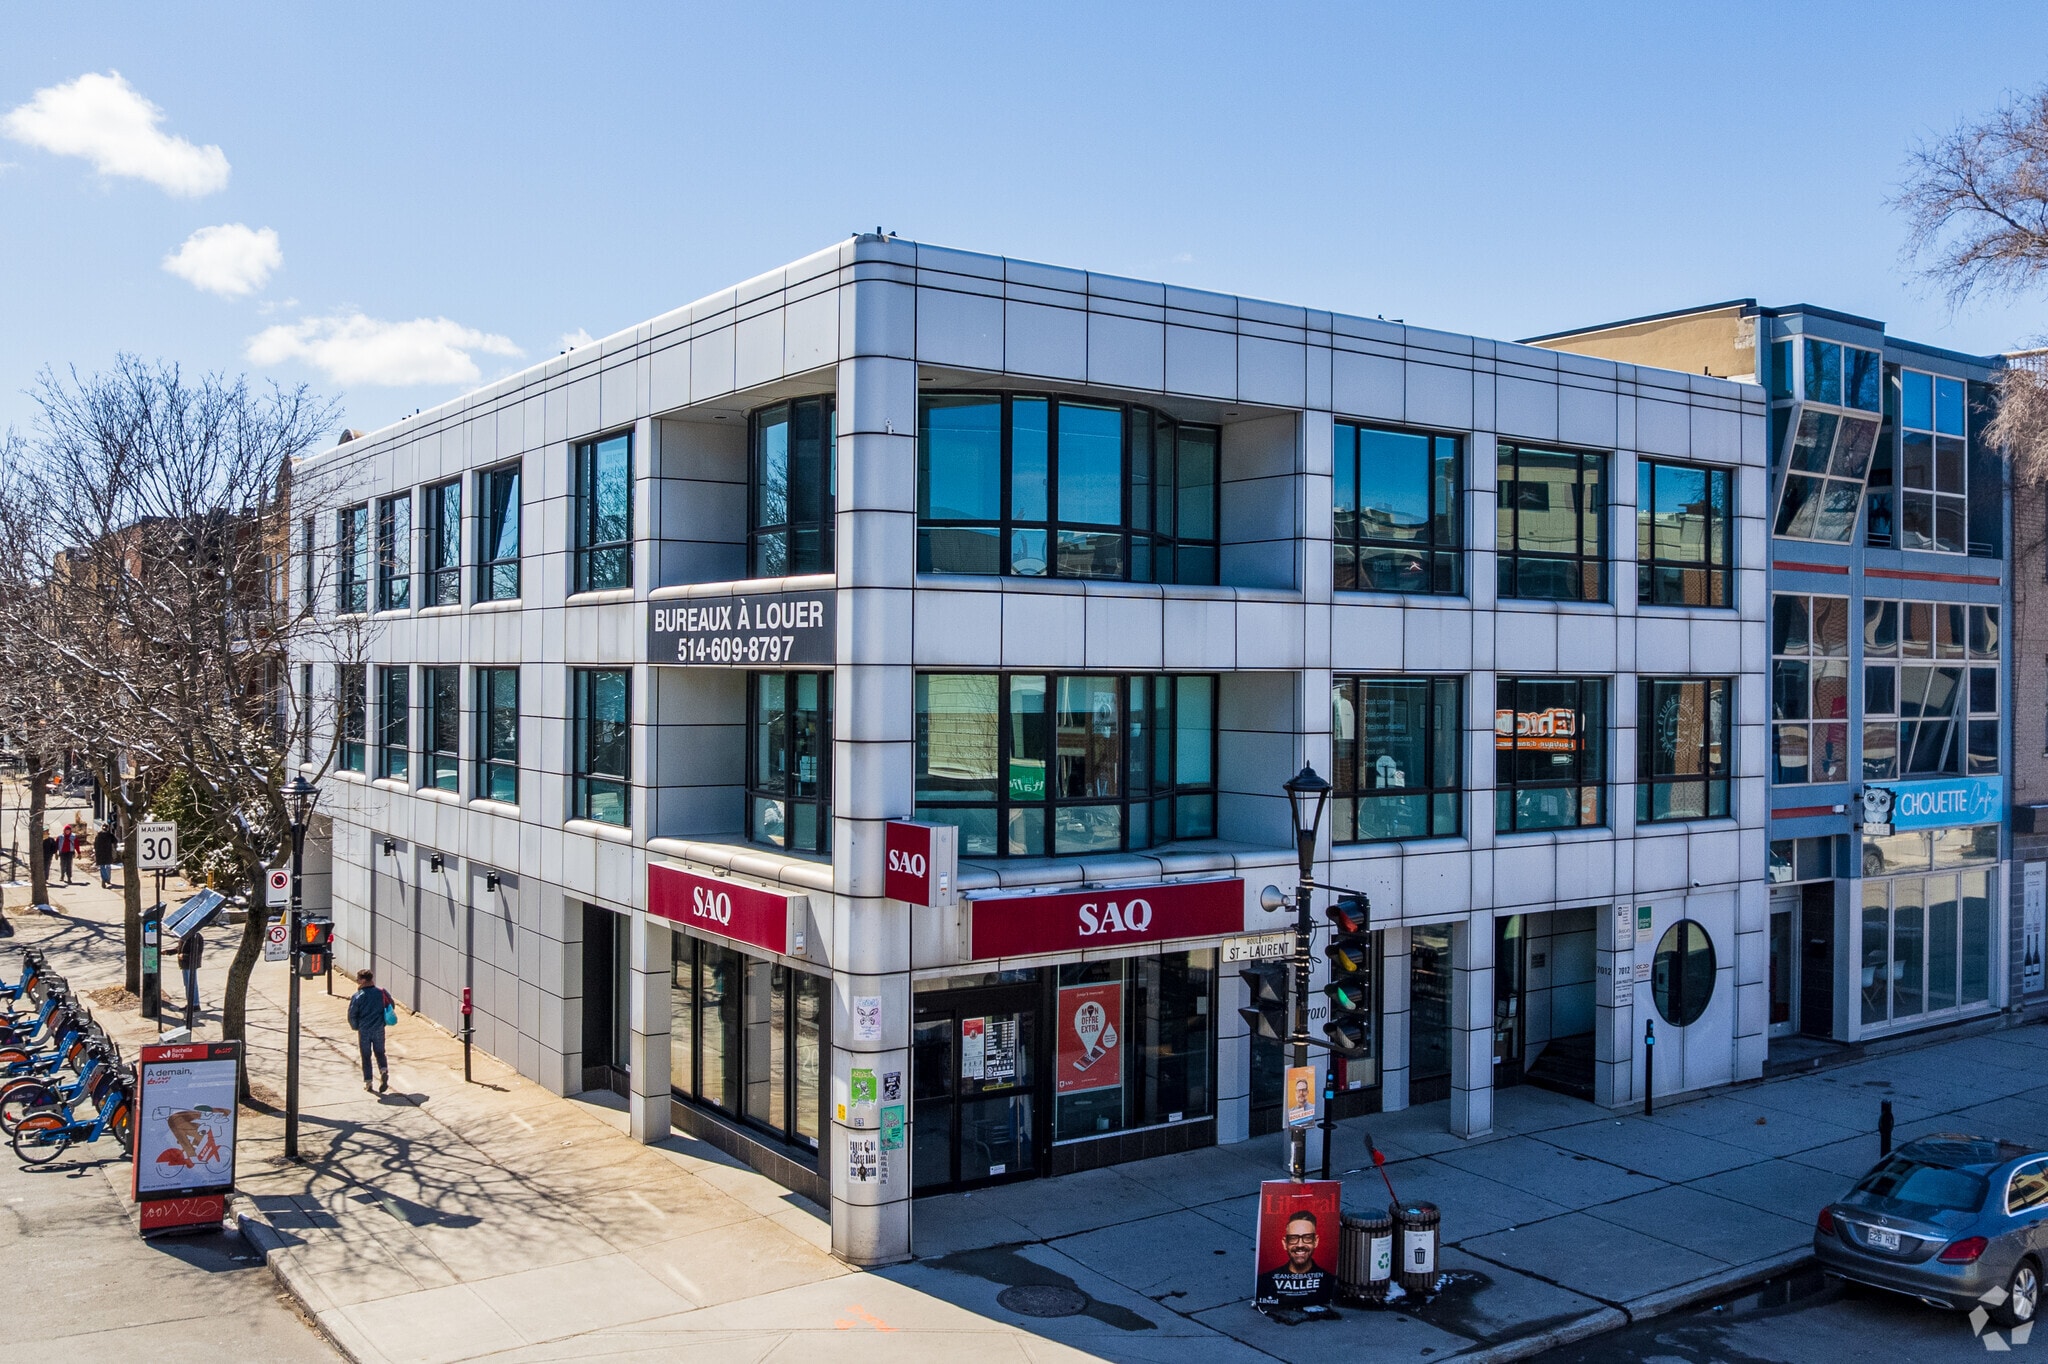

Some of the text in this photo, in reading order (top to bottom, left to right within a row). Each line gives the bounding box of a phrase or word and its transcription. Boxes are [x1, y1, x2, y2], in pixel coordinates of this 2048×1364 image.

[655, 598, 824, 633] BUREAUX À LOUER
[677, 636, 795, 662] 514-609-8797
[1900, 789, 1968, 817] CHOUETTE
[142, 837, 172, 860] 30
[888, 849, 927, 879] SAQ
[692, 885, 732, 927] SAQ
[1078, 898, 1153, 937] SAQ
[1597, 966, 1613, 976] 7012
[1618, 966, 1631, 976] 7012
[1081, 1015, 1099, 1026] OFFRE
[1081, 1024, 1099, 1034] EXTRA
[147, 1067, 193, 1077] À demain,
[1271, 1272, 1324, 1280] JEAN-SÉBASTIEN
[1274, 1278, 1321, 1290] VALLÉE
